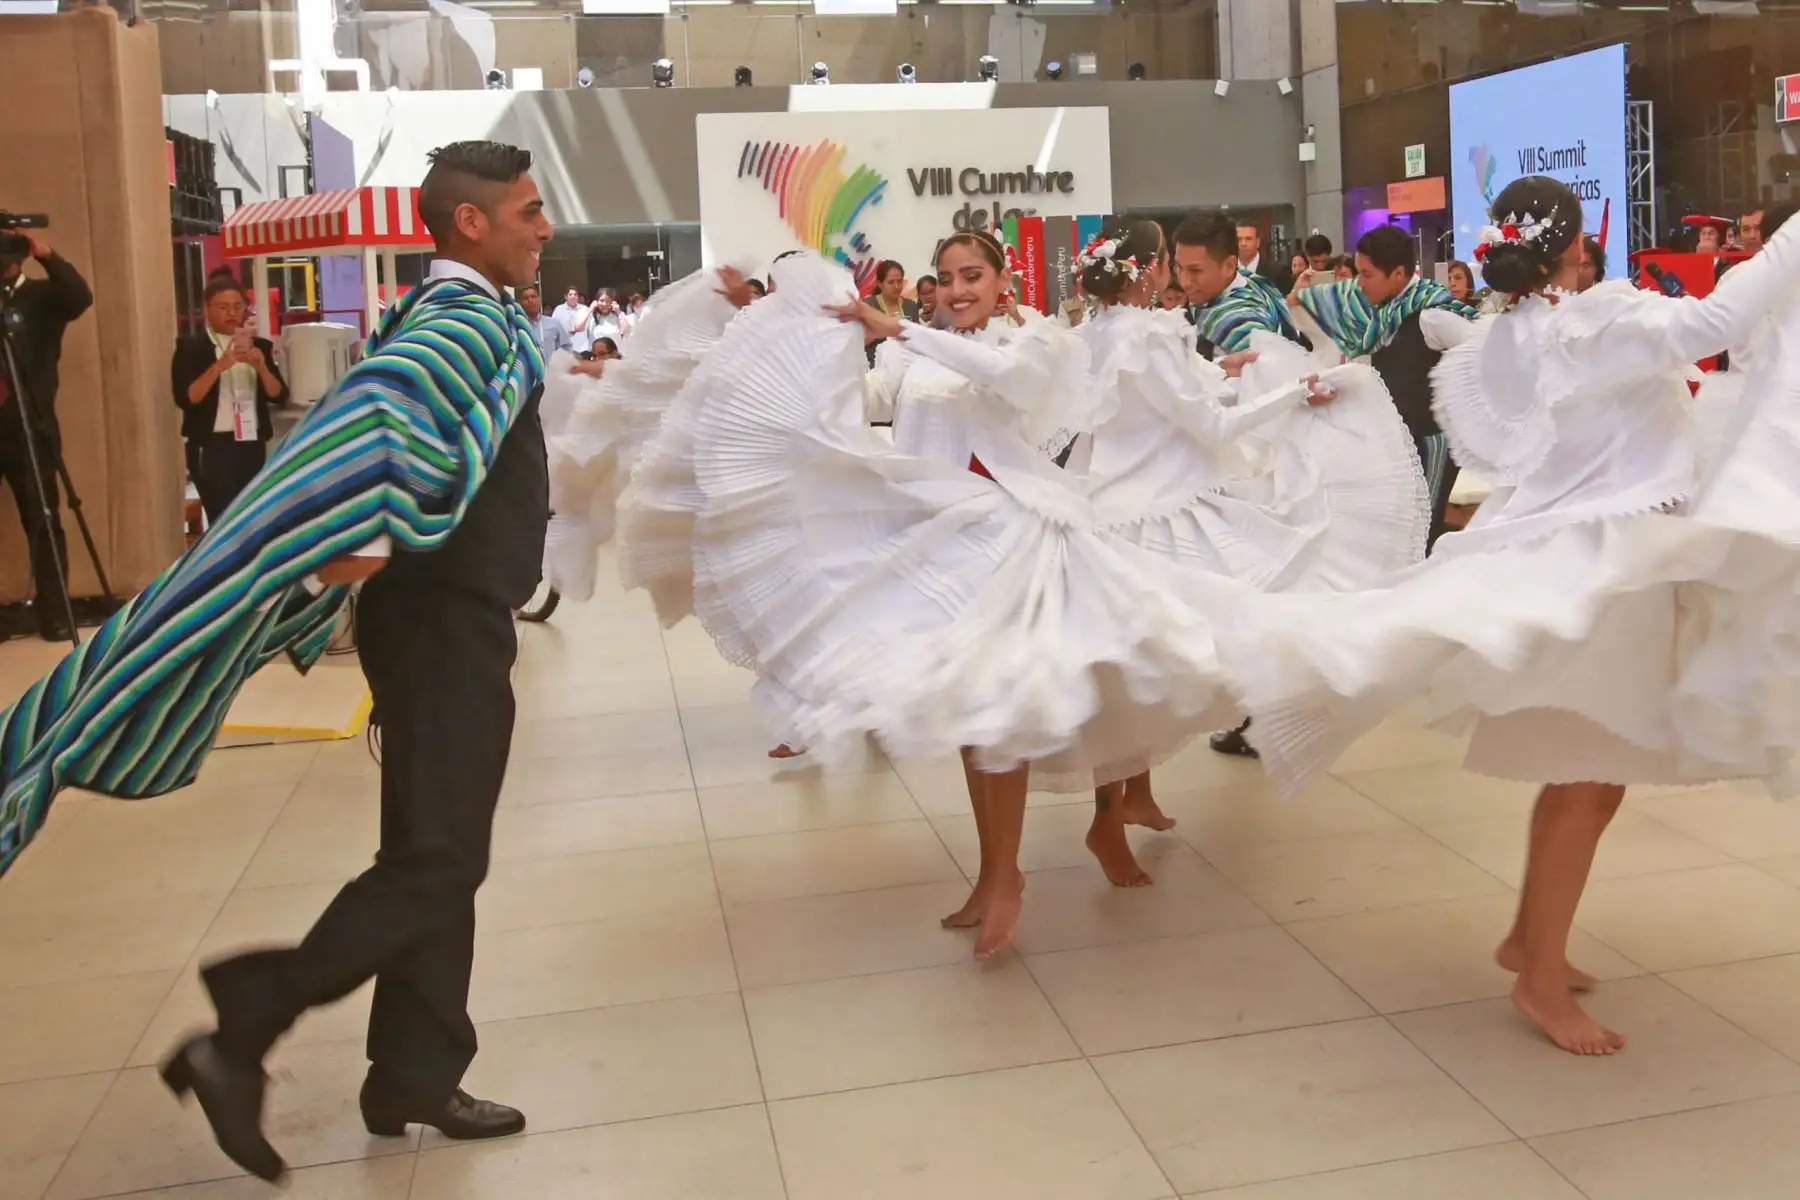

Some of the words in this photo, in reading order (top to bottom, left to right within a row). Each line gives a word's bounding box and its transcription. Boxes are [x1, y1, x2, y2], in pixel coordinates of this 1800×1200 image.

[1518, 147, 1535, 175] VIII
[1537, 139, 1587, 172] Summit
[906, 168, 952, 196] VIII
[959, 164, 1075, 196] Cumbre
[1566, 174, 1600, 201] ricas
[952, 202, 989, 231] de
